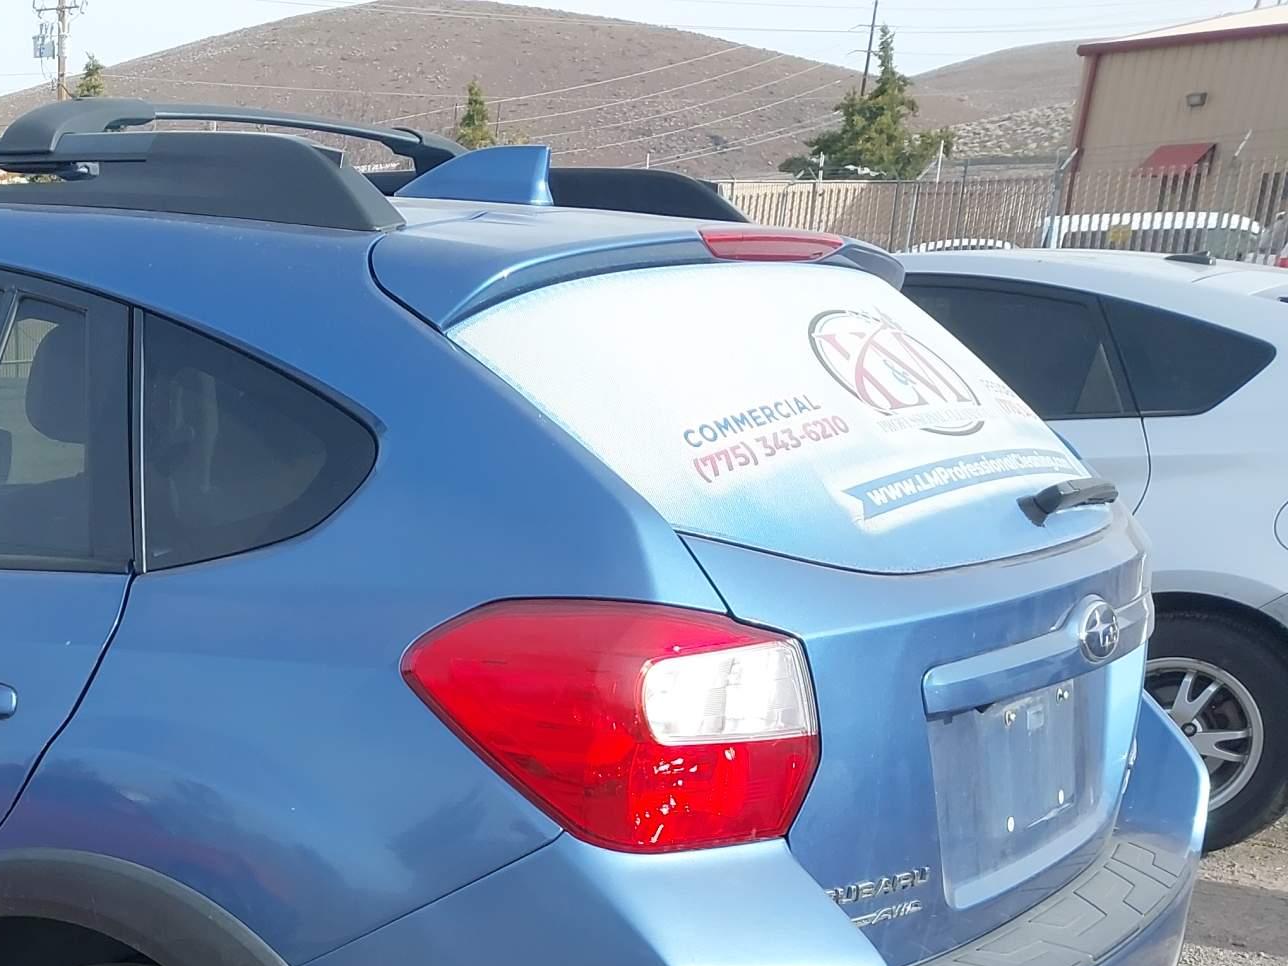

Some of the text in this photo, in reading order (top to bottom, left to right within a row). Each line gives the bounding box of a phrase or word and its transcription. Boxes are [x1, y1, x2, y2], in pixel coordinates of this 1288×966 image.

[683, 394, 821, 448] COMMERCIAL
[693, 440, 759, 483] (775)
[754, 415, 850, 457] 343-6210
